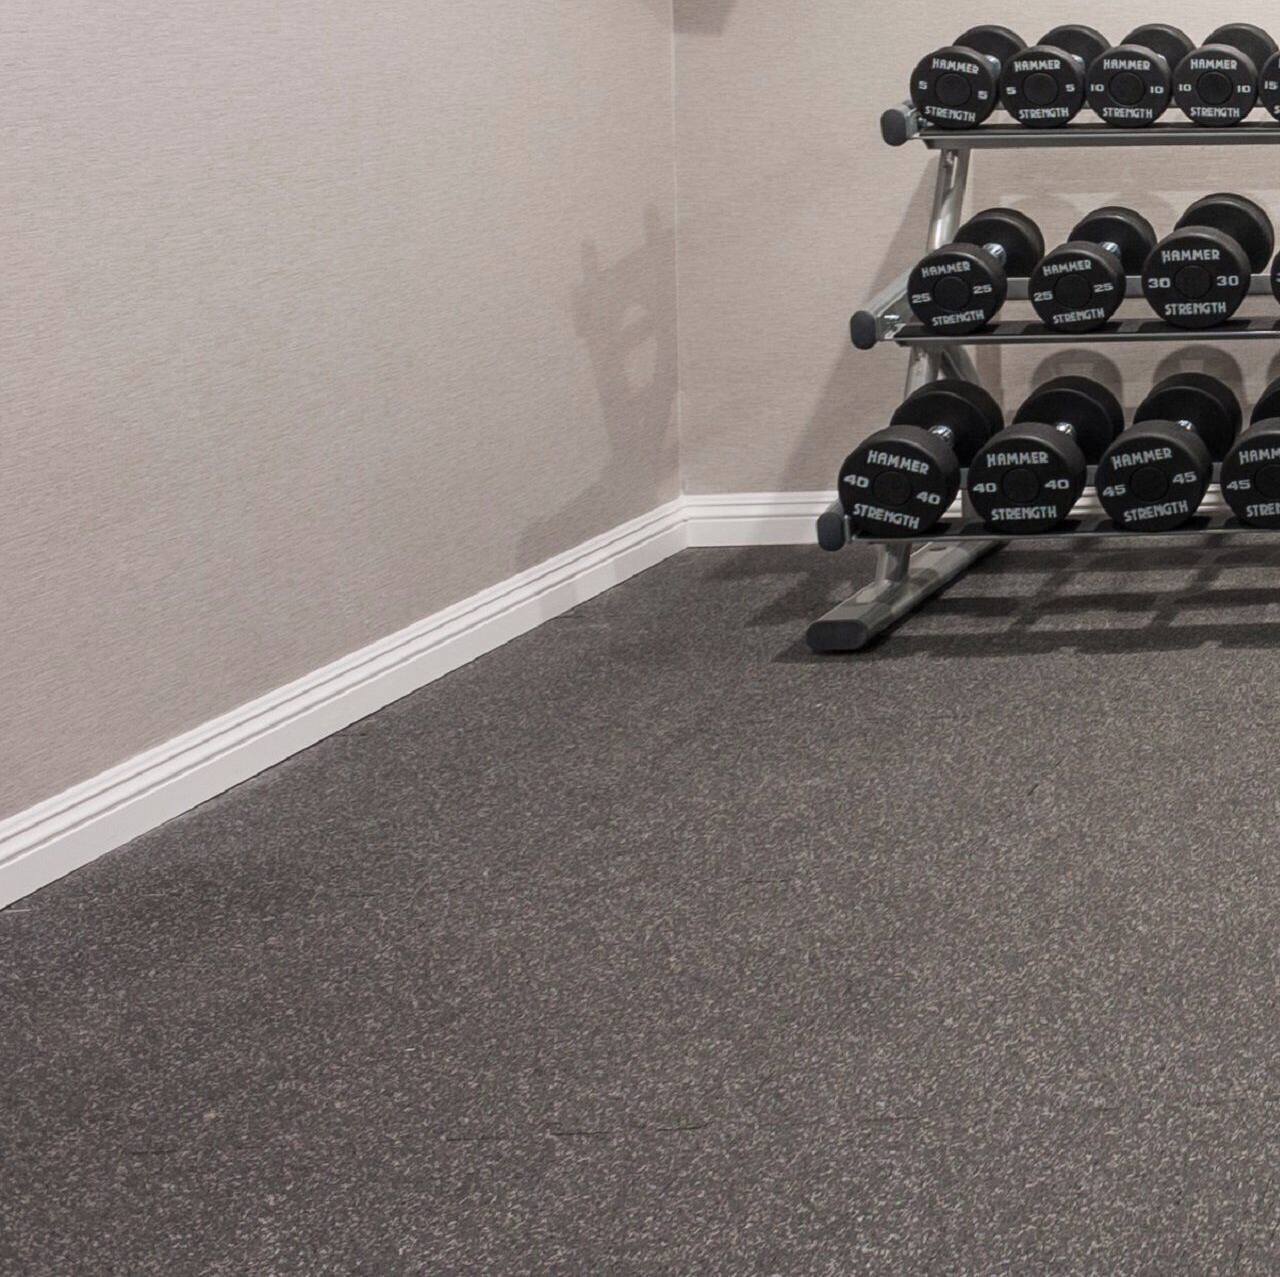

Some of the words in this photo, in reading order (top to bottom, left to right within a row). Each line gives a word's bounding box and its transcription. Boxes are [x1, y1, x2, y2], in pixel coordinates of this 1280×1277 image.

[932, 58, 979, 74] HAMMER
[1014, 60, 1060, 72] HAMMER
[1104, 59, 1150, 70] HAMMER
[1191, 59, 1237, 69] HAMMER
[919, 81, 927, 89] 5
[978, 91, 987, 99] 5
[1265, 81, 1277, 89] 15
[924, 106, 975, 122] STRENGTH
[1019, 108, 1069, 119] STRENGTH
[1103, 108, 1152, 118] STRENGTH
[1191, 107, 1239, 117] STRENGTH
[1162, 249, 1219, 263] HAMMER
[922, 261, 970, 277] HAMMER
[1043, 260, 1091, 276] HAMMER
[1149, 278, 1170, 288] 30
[1217, 276, 1238, 286] 30
[912, 293, 931, 303] 25
[973, 285, 992, 294] 25
[1034, 291, 1052, 301] 25
[1094, 283, 1113, 292] 25
[1053, 308, 1104, 324] STRENGTH
[1165, 302, 1226, 315] STRENGTH
[932, 310, 984, 326] STRENGTH
[867, 449, 931, 474] HAMMER
[987, 452, 1048, 467] HAMMER
[1112, 448, 1172, 469] HAMMER
[844, 475, 869, 487] 40
[917, 492, 940, 504] 40
[973, 483, 996, 492] 40
[1045, 479, 1069, 489] 40
[1103, 485, 1125, 496] 45
[1173, 472, 1196, 483] 45
[1227, 480, 1250, 490] 45
[853, 504, 919, 529] STRENGTH
[992, 506, 1056, 520] STRENGTH
[1124, 500, 1188, 522] STRENGTH
